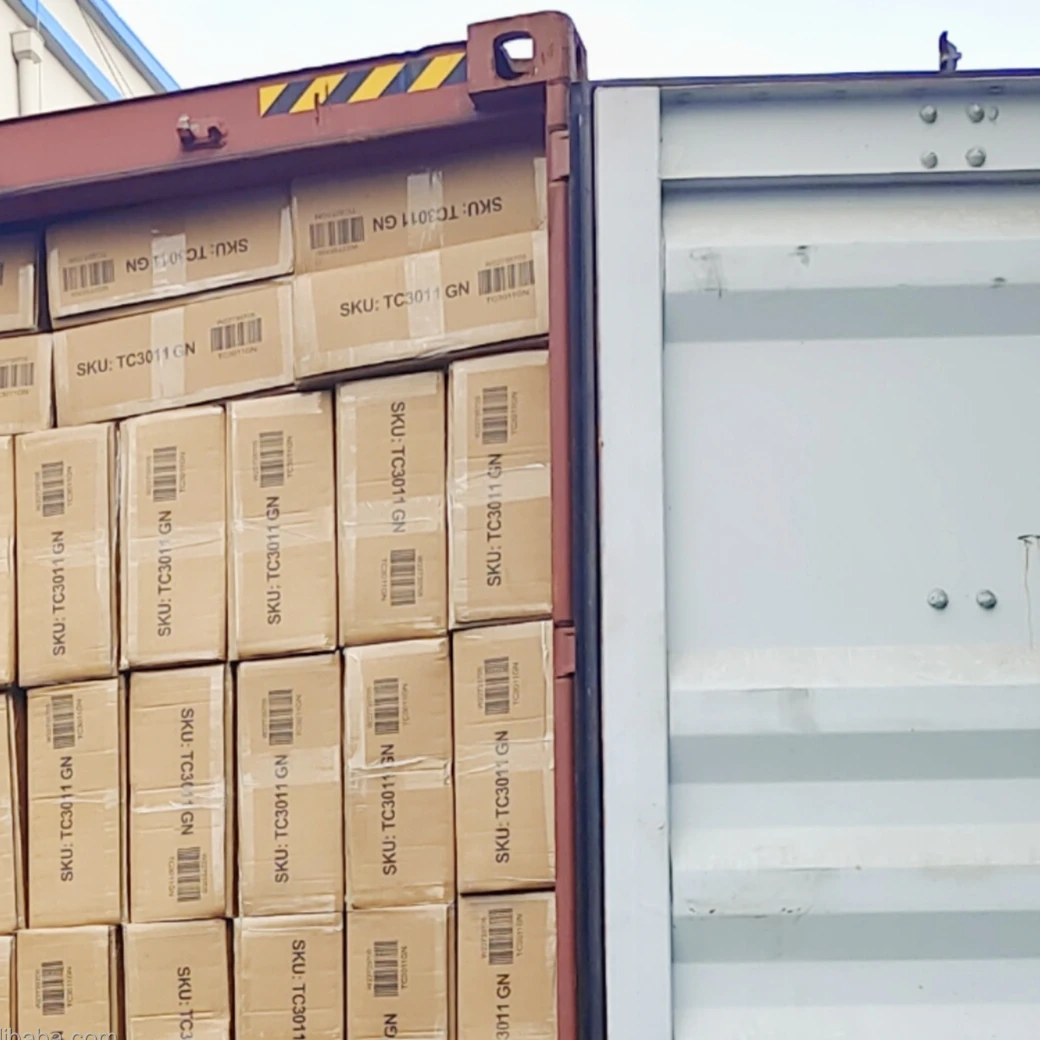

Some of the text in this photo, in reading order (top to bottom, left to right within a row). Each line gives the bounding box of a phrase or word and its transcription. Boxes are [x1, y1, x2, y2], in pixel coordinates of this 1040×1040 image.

[372, 196, 503, 233] SKU: TC3011 GN
[339, 280, 470, 318] SKU: TC3011 GN
[75, 340, 196, 377] SKU: TC3011 GN
[390, 401, 407, 533] SKU: TC3011 GN
[265, 496, 282, 625] SKU: TC3011 GN
[51, 530, 66, 657] SKU: TC3011 GN
[59, 755, 74, 882] SKU: TC3011 GN
[274, 754, 290, 884] SKU: TC3011 GN
[494, 730, 511, 864] SKU: TC3011 GN
[291, 939, 306, 979] SKU:
[176, 966, 193, 1006] SKU:
[496, 973, 511, 1000] GN
[291, 983, 307, 1040] TC3011
[383, 1013, 399, 1039] GN
